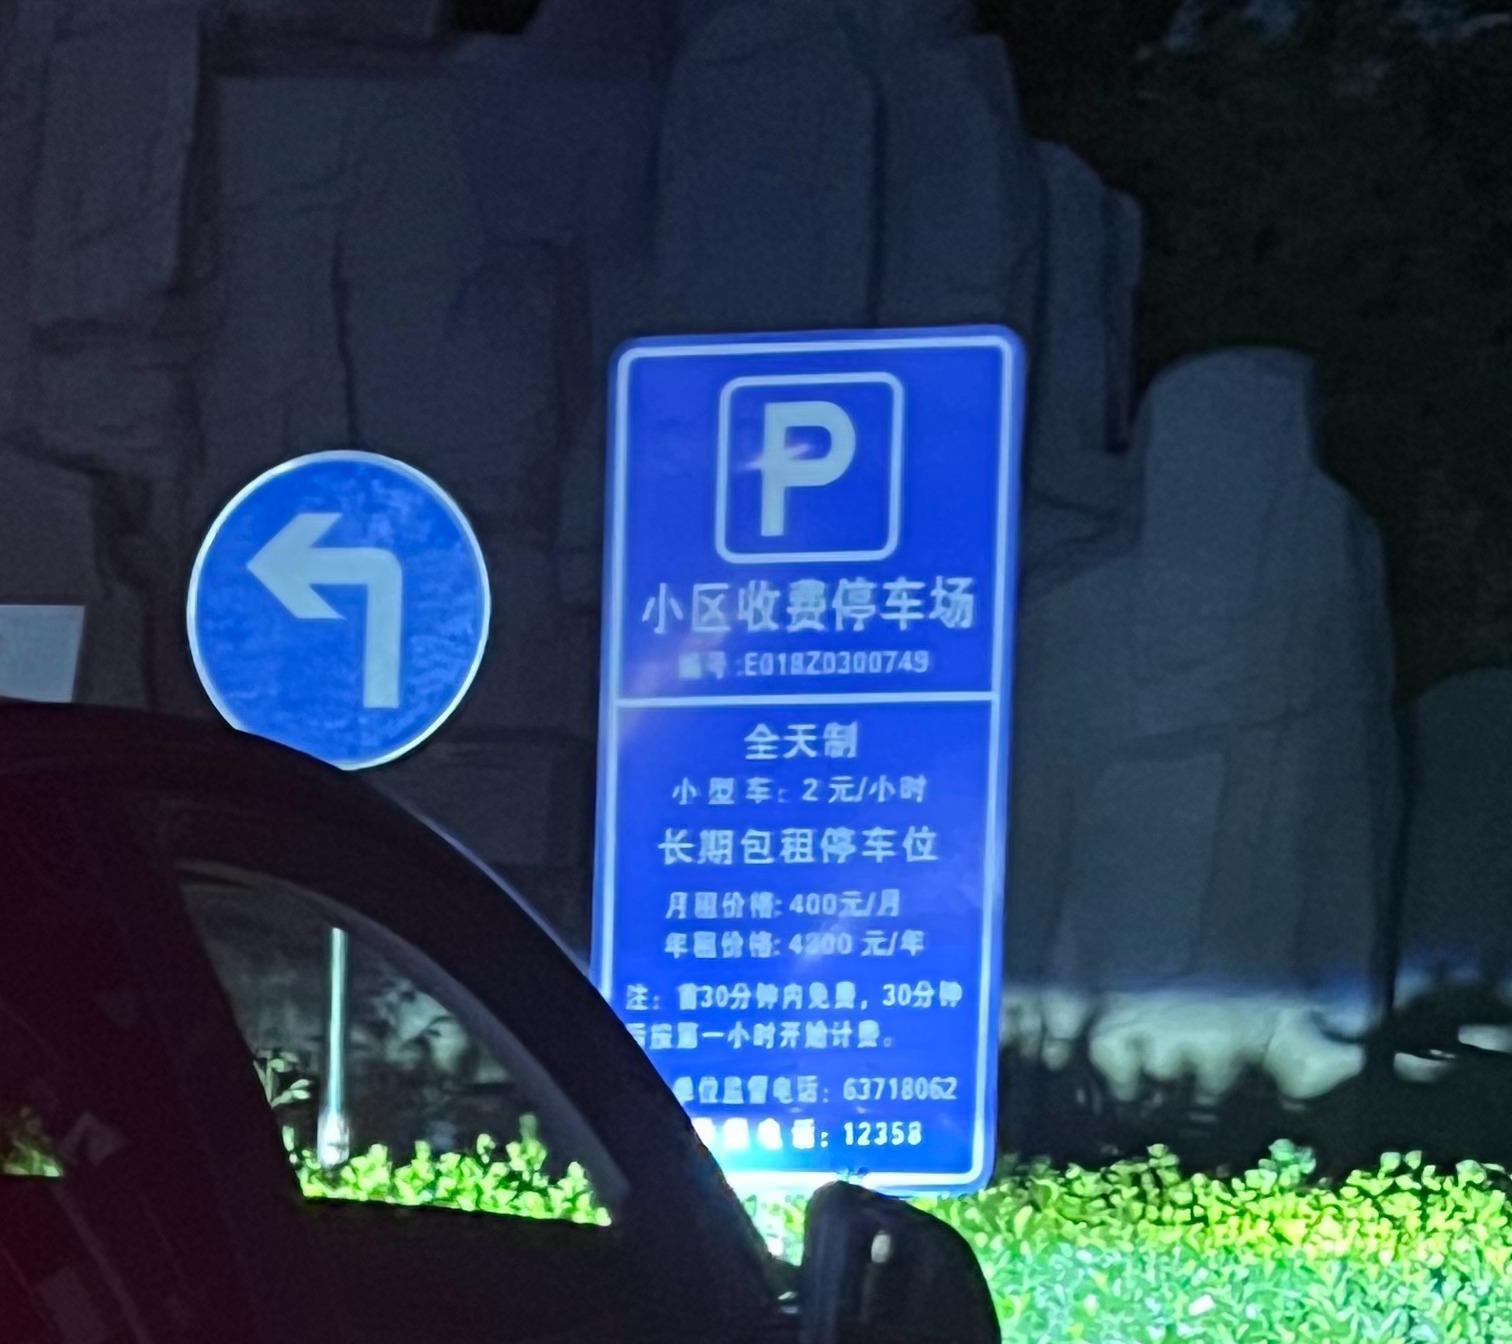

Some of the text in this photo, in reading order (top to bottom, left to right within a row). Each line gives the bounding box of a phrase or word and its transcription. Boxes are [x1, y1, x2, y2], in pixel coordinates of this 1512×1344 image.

[761, 401, 856, 537] P
[642, 576, 975, 633] 小区收费停车场
[744, 721, 858, 760] 全天制
[658, 826, 939, 865] 长期包租停车位
